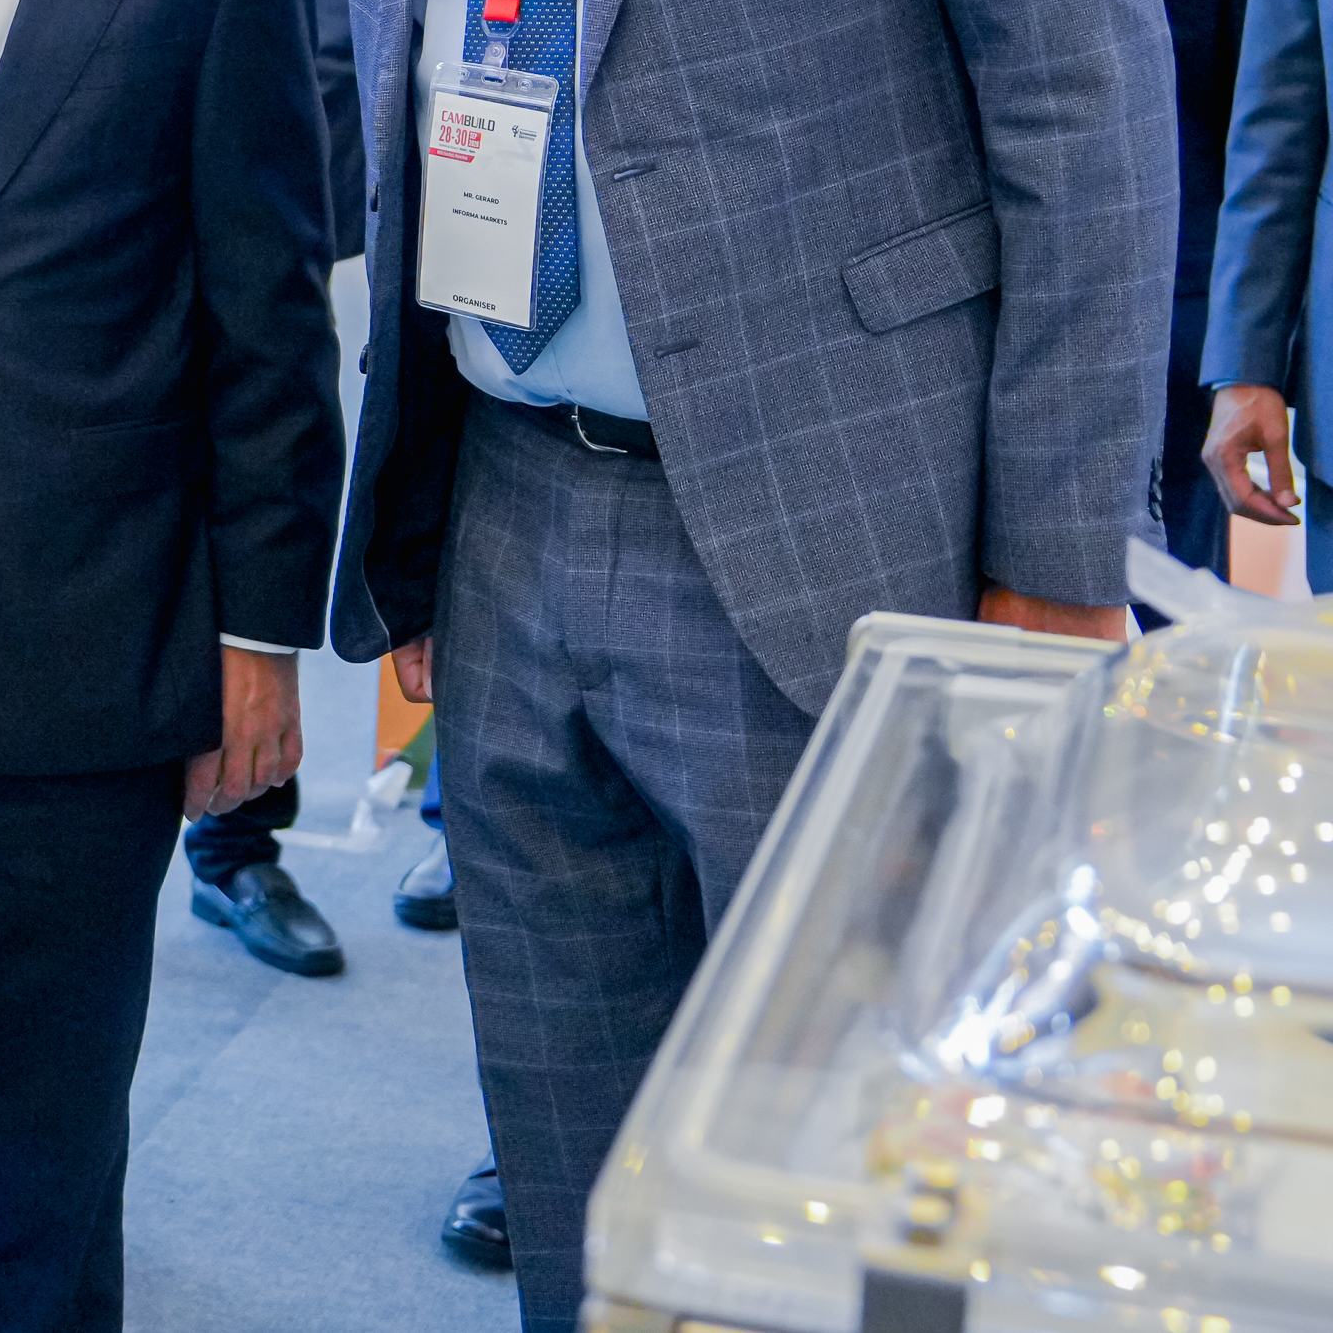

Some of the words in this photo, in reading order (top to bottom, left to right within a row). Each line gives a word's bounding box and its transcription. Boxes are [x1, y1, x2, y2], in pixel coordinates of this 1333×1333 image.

[441, 110, 495, 132] CAMBUILD
[439, 125, 468, 146] 28-30
[463, 192, 474, 200] MR.
[475, 194, 500, 205] GERARD
[452, 208, 479, 220] INFORMA
[480, 214, 508, 226] MARKETS
[452, 294, 496, 312] ORGANISER
